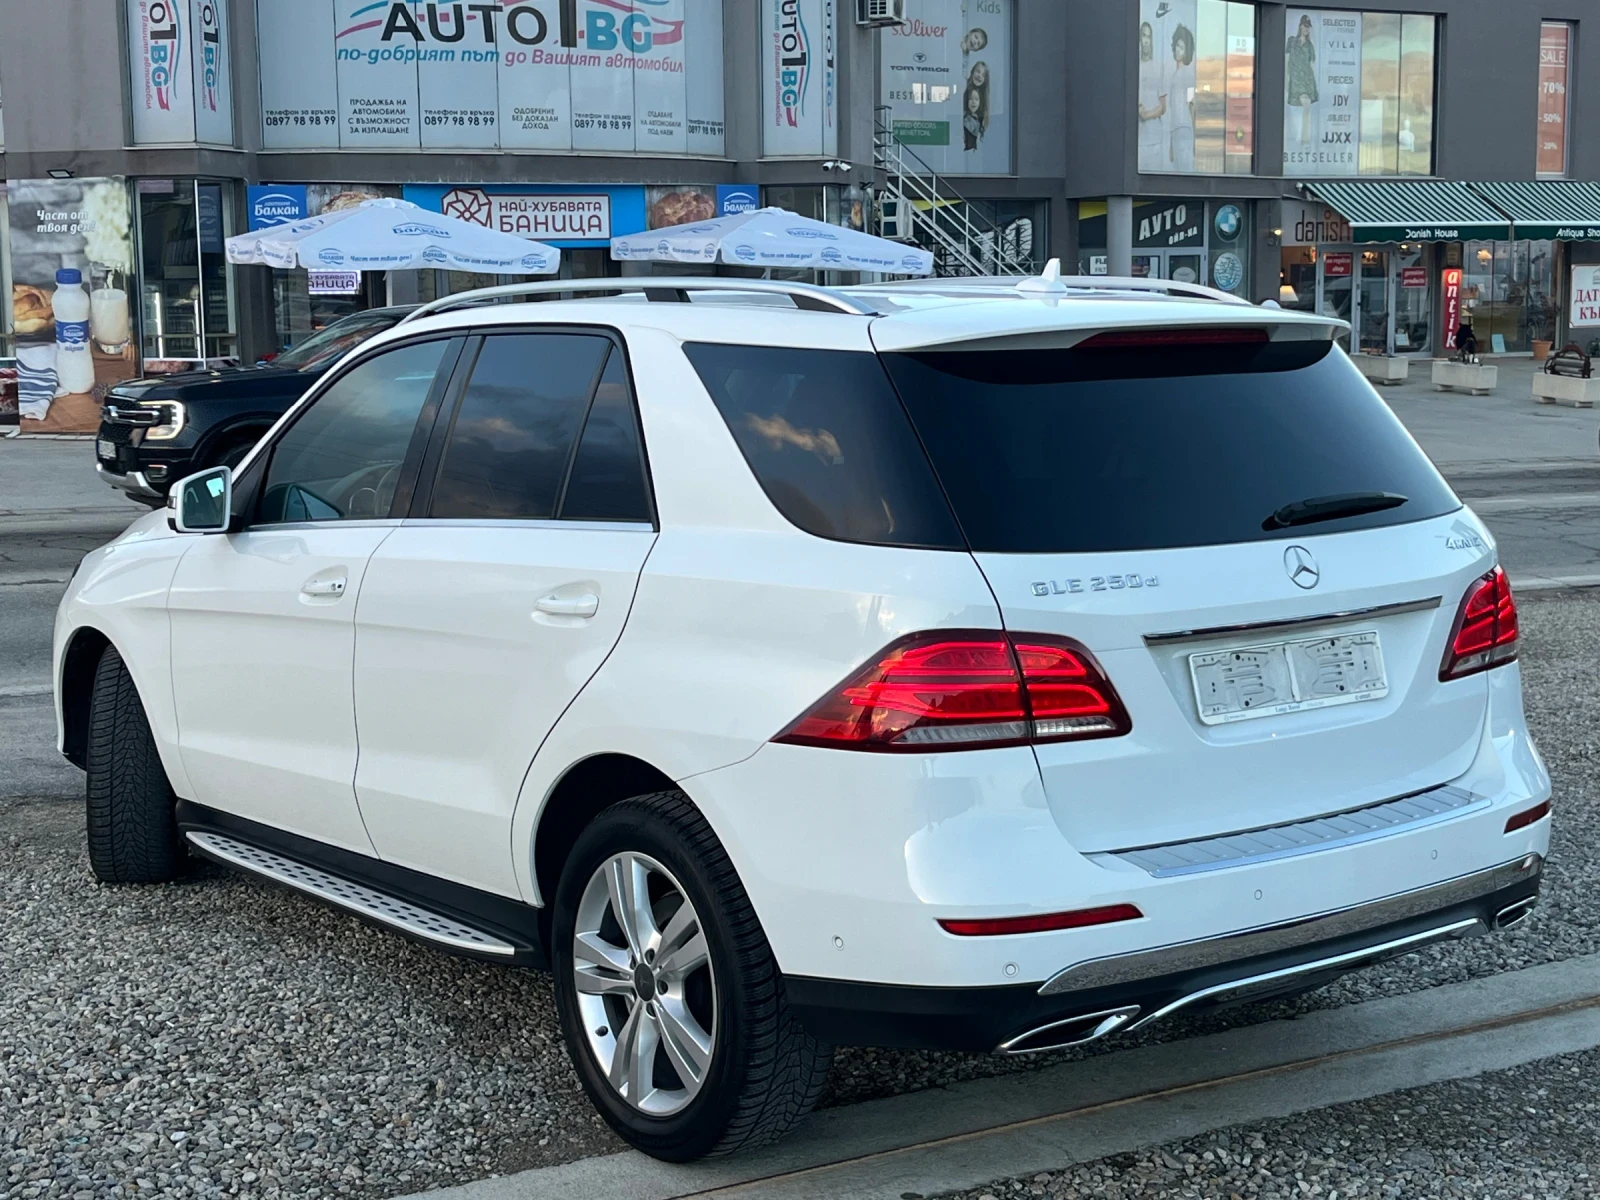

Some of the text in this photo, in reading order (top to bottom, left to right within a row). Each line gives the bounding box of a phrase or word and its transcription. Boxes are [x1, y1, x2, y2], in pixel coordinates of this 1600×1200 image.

[976, 1, 1001, 14] Kids
[1322, 18, 1356, 27] SELECTED
[1328, 40, 1355, 48] VILA
[337, 44, 499, 65] по-добрият път
[1540, 50, 1565, 63] SALE
[505, 49, 683, 73] до Вашият автомобил
[1328, 75, 1354, 84] PIECES
[1332, 95, 1349, 106] JDY
[265, 116, 336, 126] 0897 98 98 99
[356, 117, 410, 125] ВЪЗМОЖНОСТ
[424, 116, 495, 126] 0897 98 98 99
[522, 122, 549, 130] ДОХОД
[574, 119, 632, 130] 0897 98 98 99
[1322, 131, 1352, 144] JJXX
[1283, 151, 1353, 163] BESTSELLER
[254, 204, 300, 216] Балкан
[499, 199, 602, 212] НАЙ-ХУБАВАТА
[37, 210, 89, 221] Част от
[37, 222, 67, 233] твоя
[500, 215, 603, 236] БАНИЦА
[1406, 228, 1459, 239] Danish House
[1556, 228, 1584, 238] Antique
[318, 253, 345, 261] Балкан
[422, 250, 448, 259] Балкан
[521, 258, 547, 266] Балкан
[1445, 270, 1458, 348] antik
[1579, 305, 1600, 320] КЪ
[1031, 578, 1084, 597] GLE
